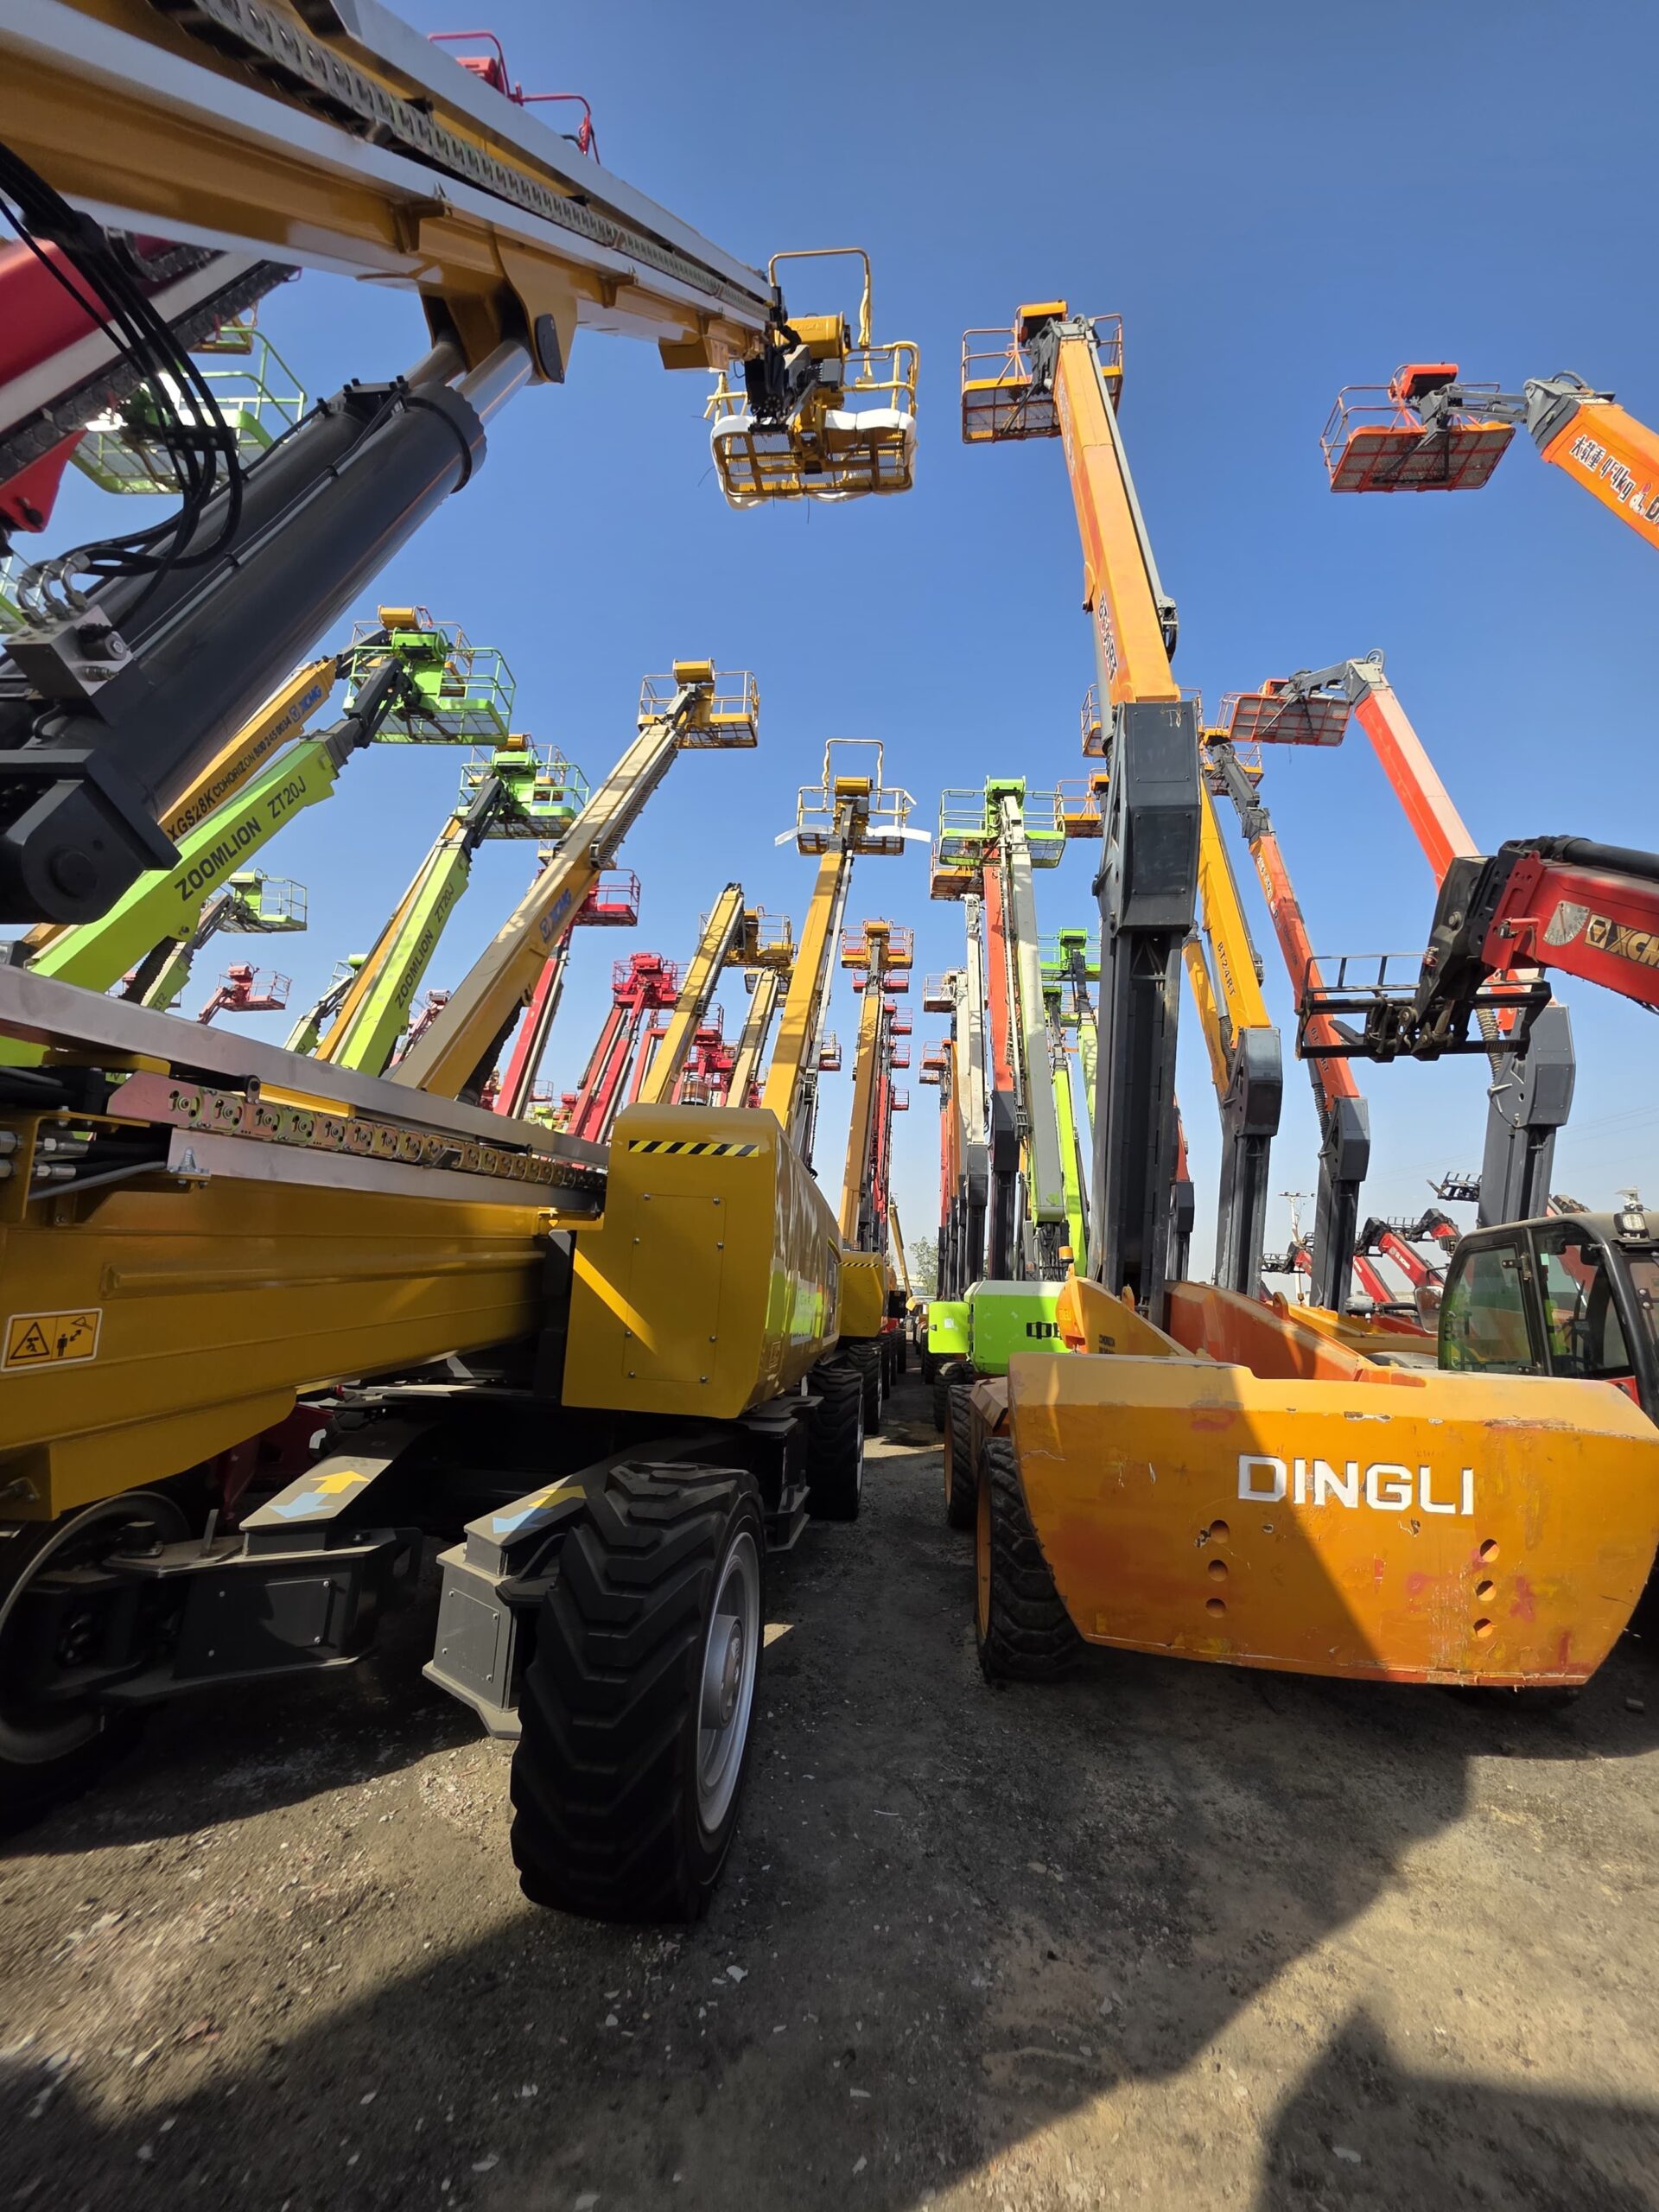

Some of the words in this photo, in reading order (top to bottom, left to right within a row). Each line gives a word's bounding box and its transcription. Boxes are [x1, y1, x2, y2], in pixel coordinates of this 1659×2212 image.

[299, 685, 322, 715] XCMG
[213, 753, 255, 798] CDHORIZON
[174, 817, 262, 901] ZOOMLION
[267, 775, 307, 819] ZT20J
[395, 929, 435, 1009] ZOOMLION
[434, 883, 454, 924] ZT20J
[1217, 942, 1236, 995] BT24RT
[1237, 1452, 1474, 1515] DINGLI
